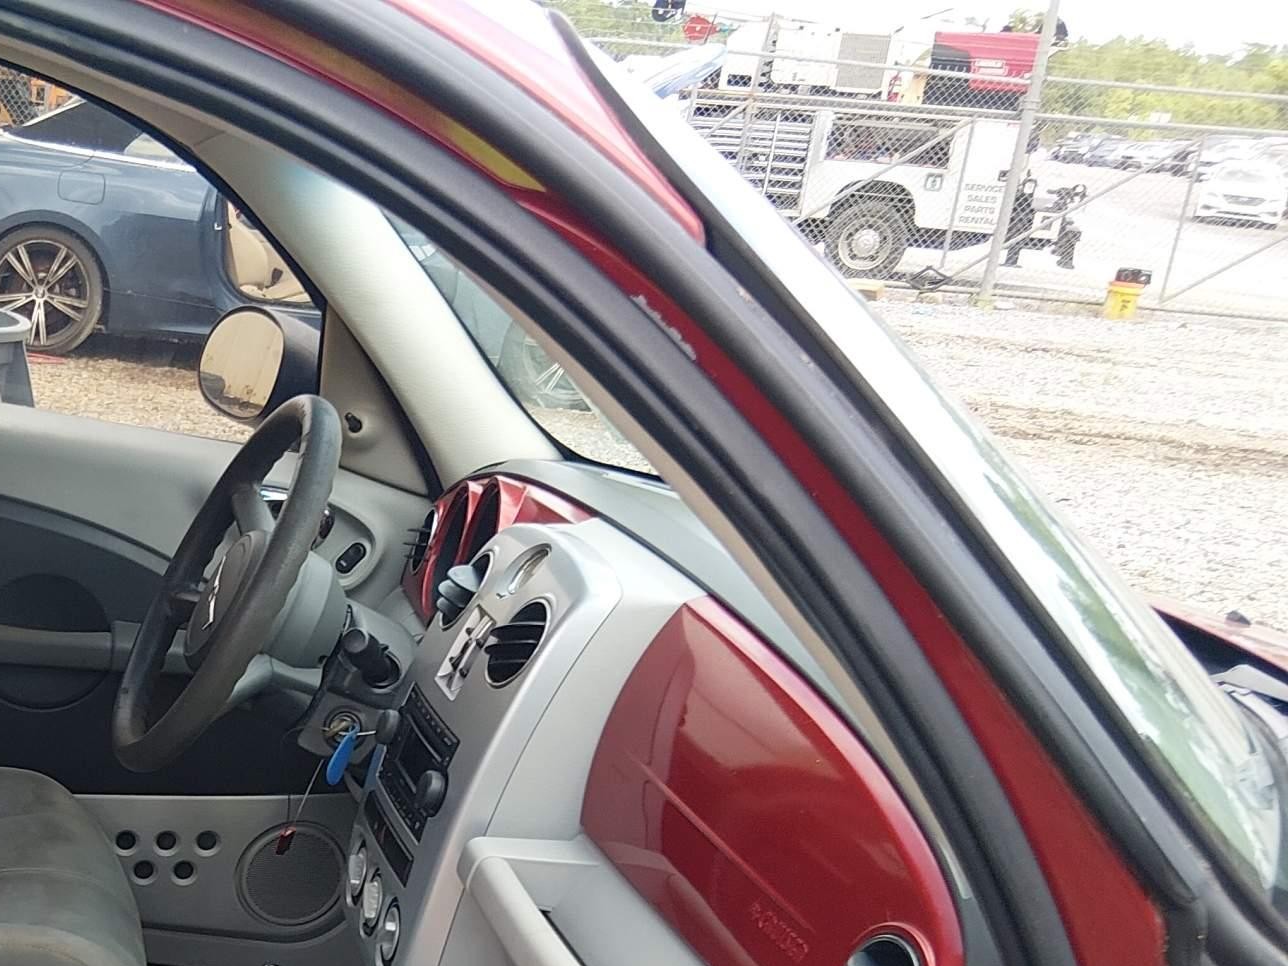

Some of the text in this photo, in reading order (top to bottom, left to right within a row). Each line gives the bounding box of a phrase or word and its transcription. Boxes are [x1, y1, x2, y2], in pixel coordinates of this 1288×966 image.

[964, 183, 1006, 194] SERVICE
[967, 194, 998, 205] SALES
[964, 205, 996, 215] PARTS
[959, 215, 997, 226] RENTAL
